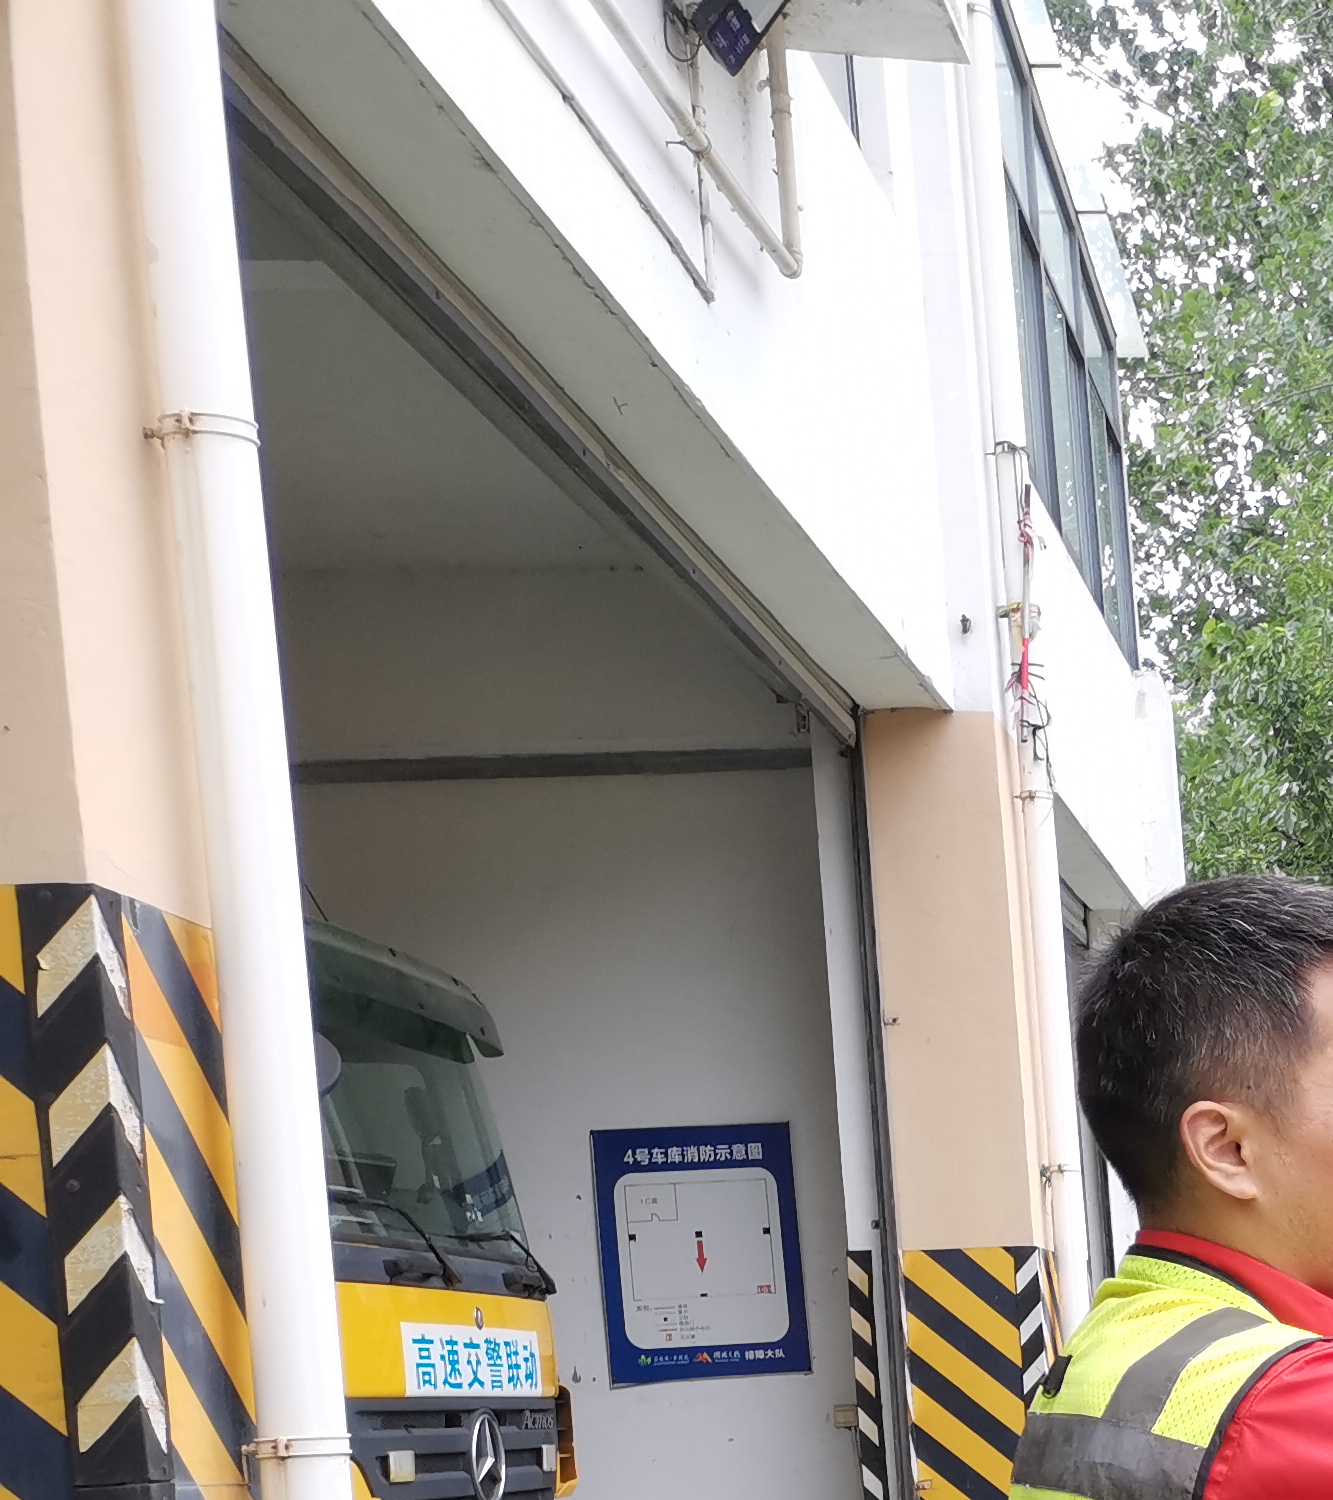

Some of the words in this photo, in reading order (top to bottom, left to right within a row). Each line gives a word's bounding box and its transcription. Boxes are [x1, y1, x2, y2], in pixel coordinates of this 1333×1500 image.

[623, 1142, 764, 1166] 4号车库消防示意图
[411, 1333, 538, 1392] 高速交警联动
